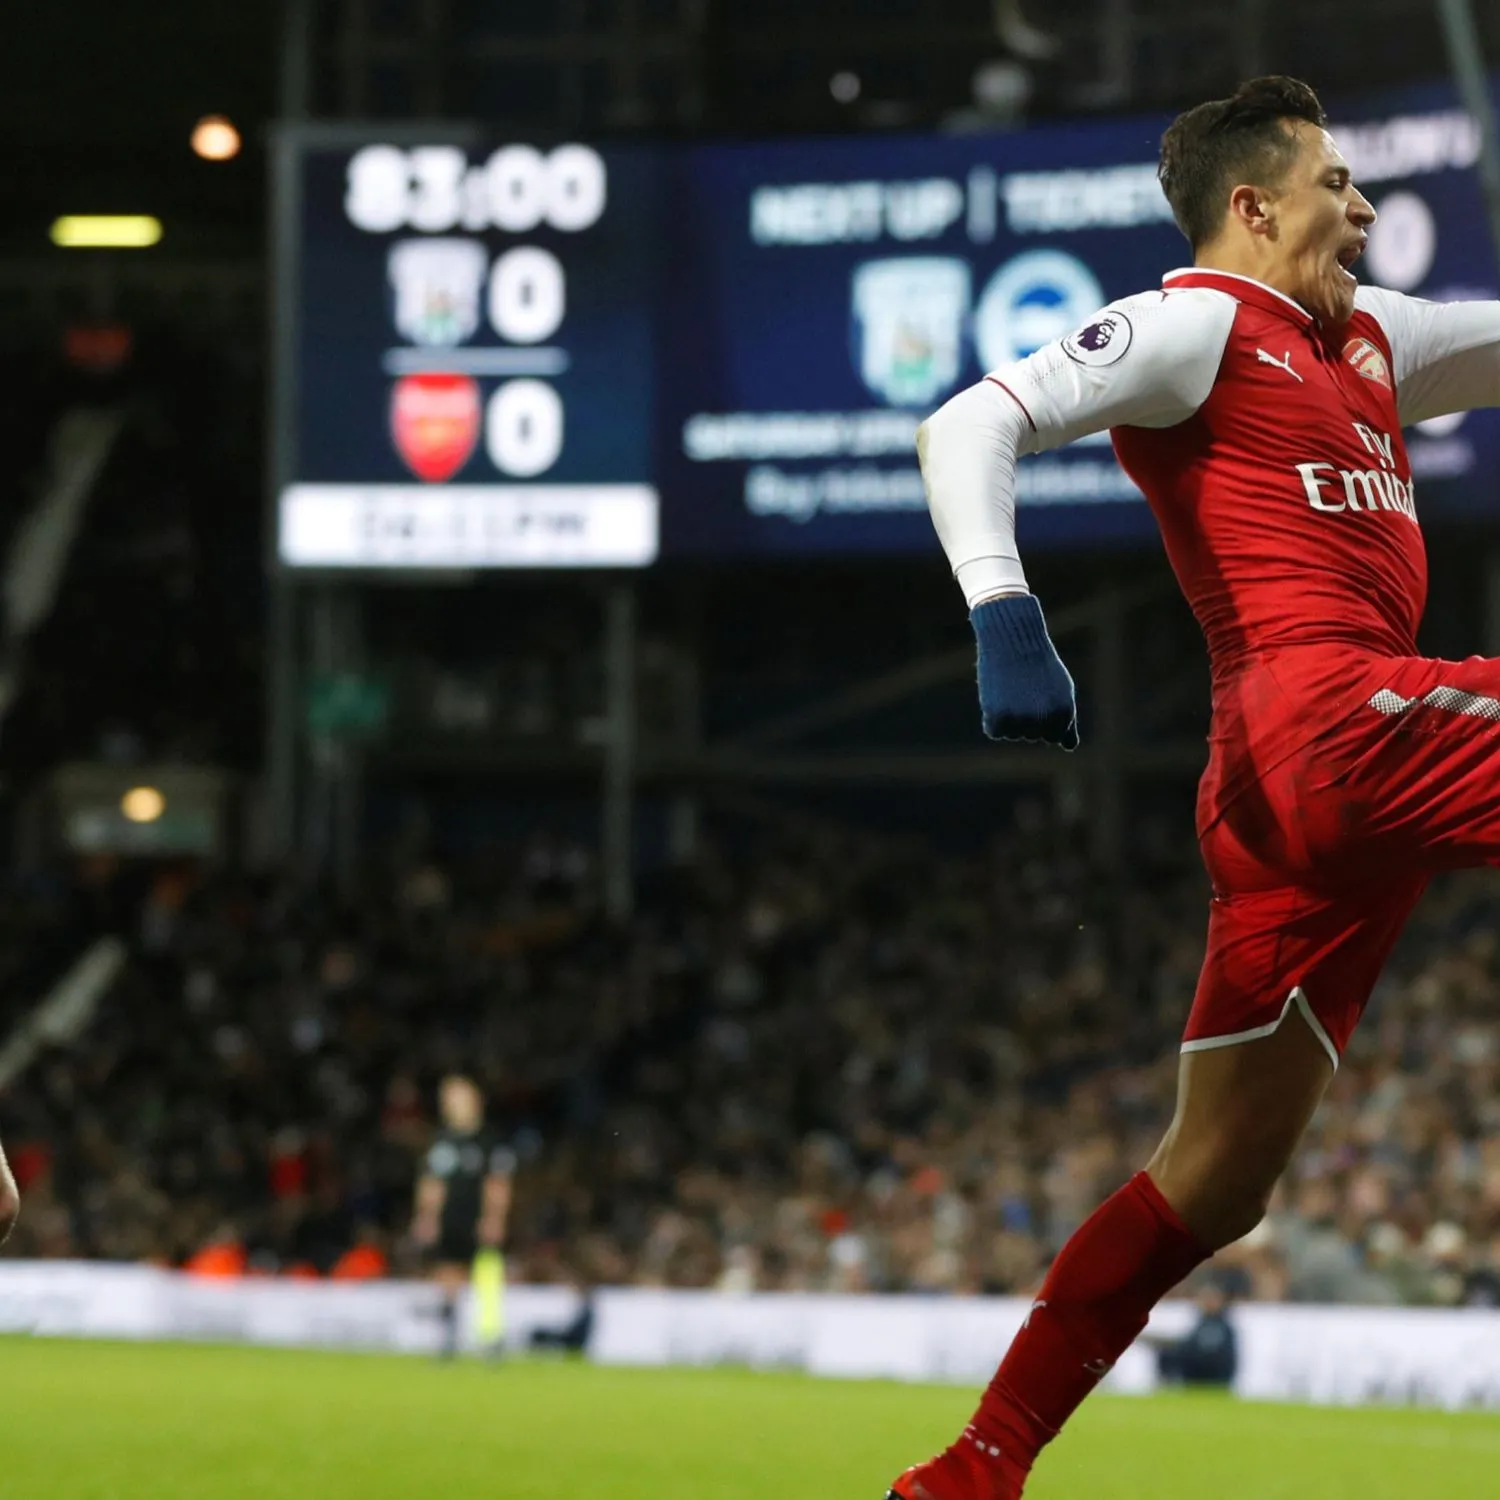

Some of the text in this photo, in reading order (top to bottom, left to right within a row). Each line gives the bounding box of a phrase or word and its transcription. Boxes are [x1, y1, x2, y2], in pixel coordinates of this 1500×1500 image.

[347, 144, 605, 232] 83:00
[750, 182, 882, 246] NEXT
[886, 178, 964, 240] UP
[488, 246, 564, 343] 0
[486, 378, 562, 478] 0
[1352, 422, 1395, 469] Fly
[1295, 462, 1418, 524] Emirat
